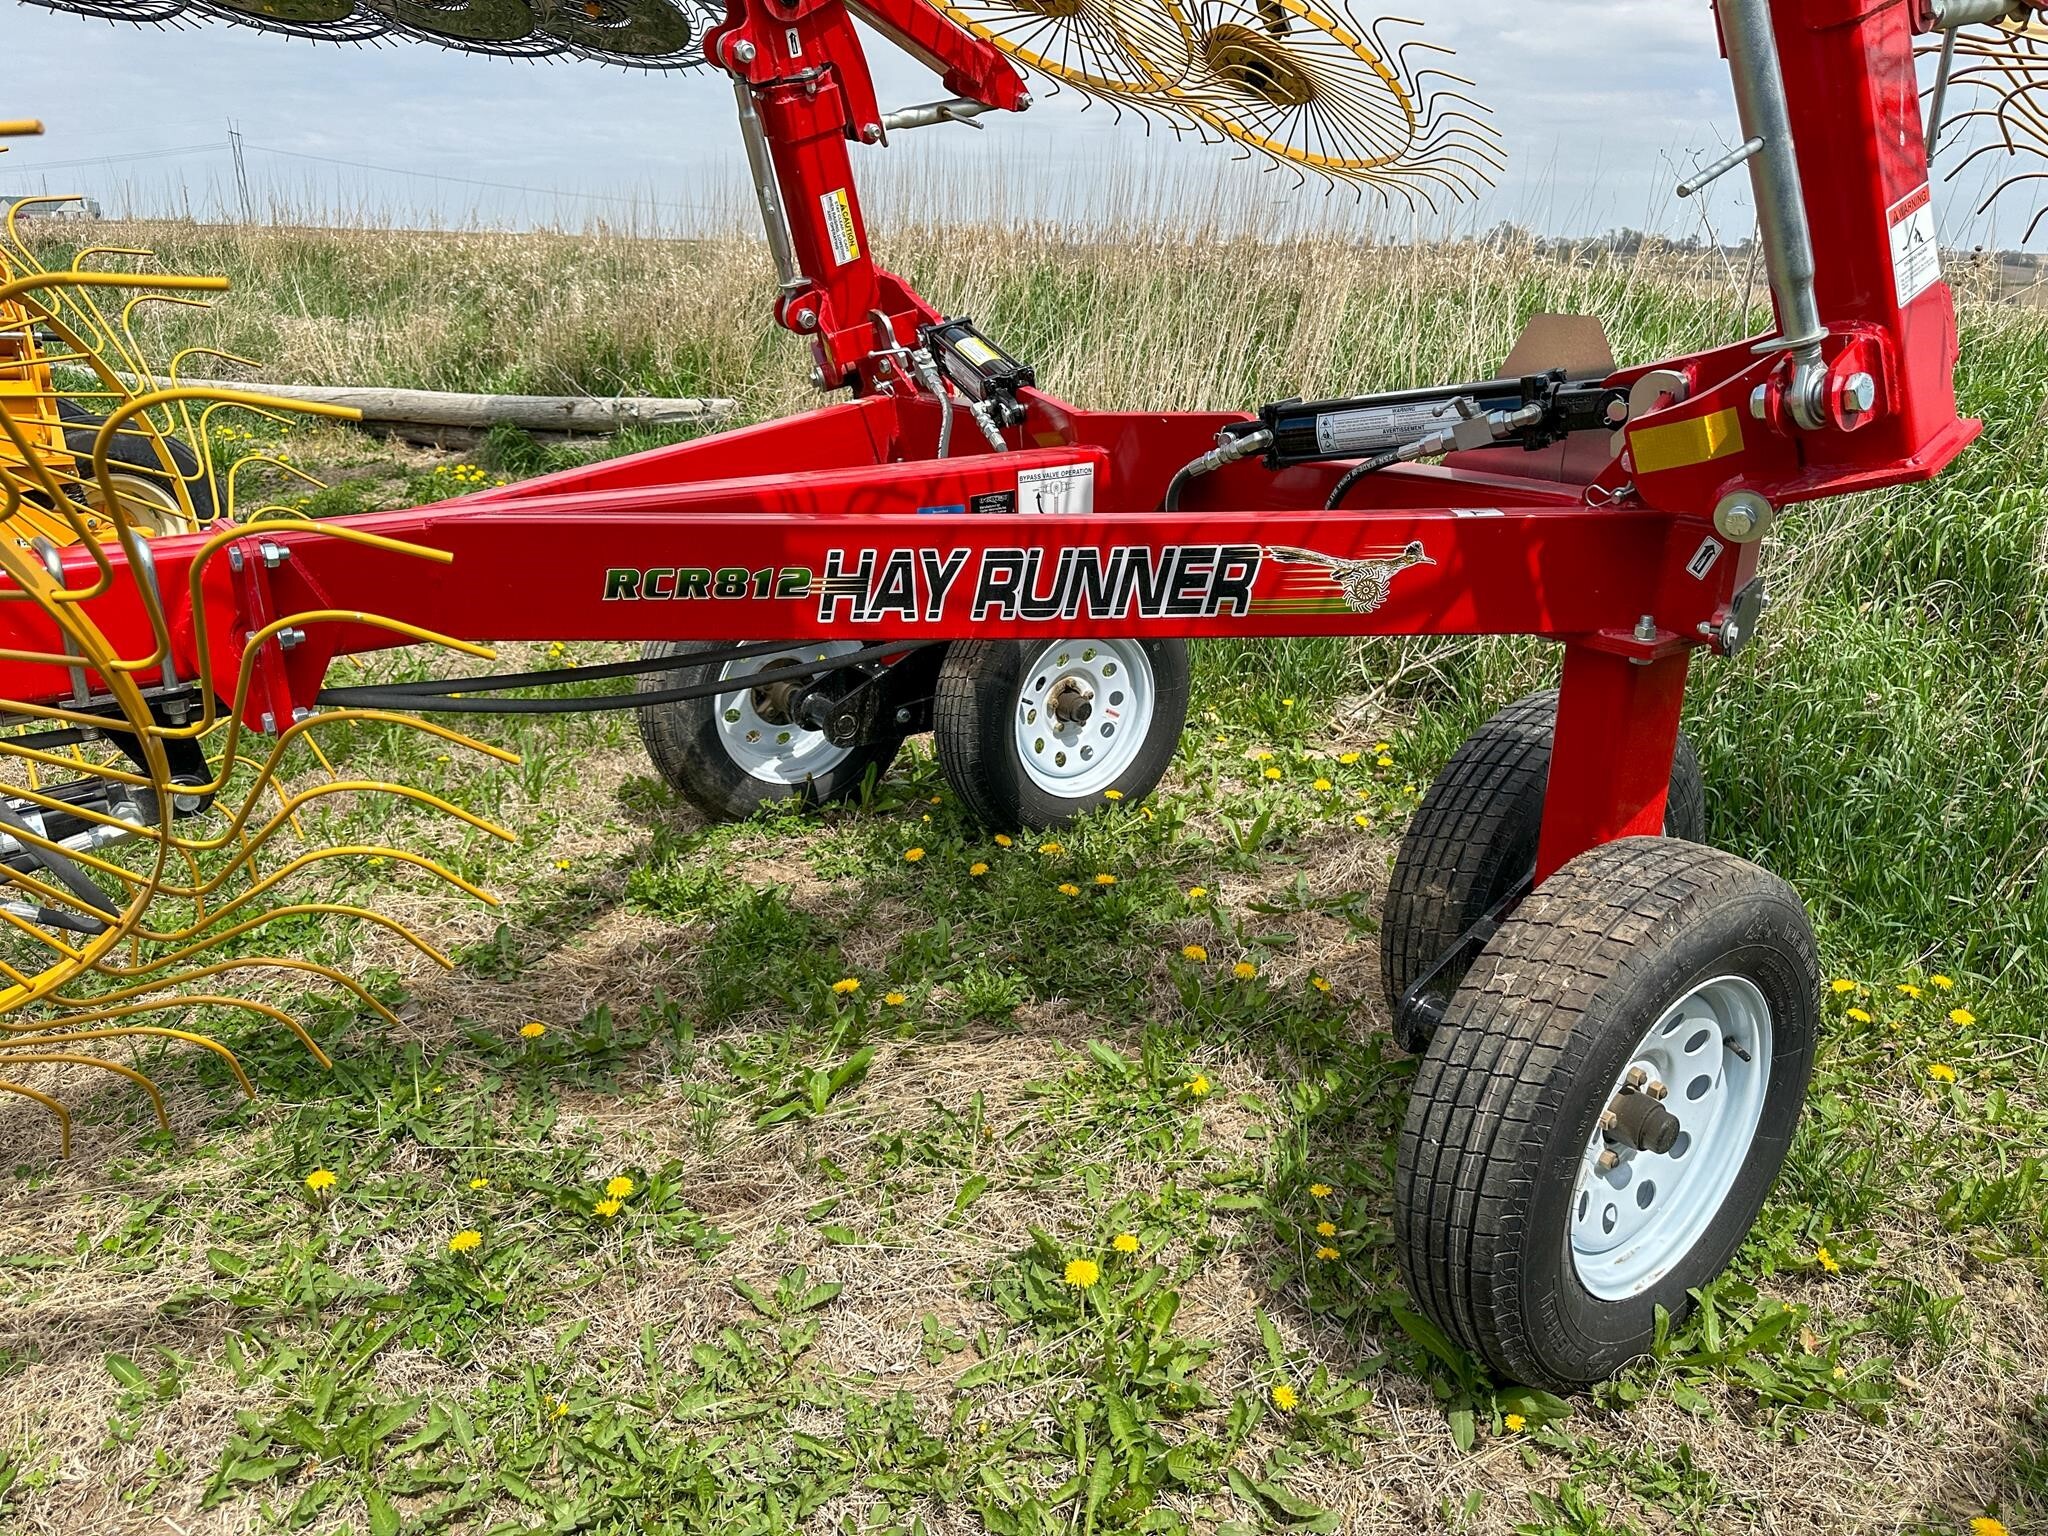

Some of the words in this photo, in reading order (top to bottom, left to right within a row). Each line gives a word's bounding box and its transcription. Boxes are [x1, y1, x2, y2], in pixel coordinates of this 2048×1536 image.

[1899, 191, 1927, 217] WARNING
[842, 211, 856, 247] CAUTION
[1382, 424, 1425, 434] AVERTISSEMENT
[1019, 473, 1041, 482] BYPASS
[1042, 471, 1060, 479] VALVE
[1060, 467, 1092, 477] OPERATION
[602, 566, 813, 600] RCR812
[817, 548, 971, 622] HAY
[969, 545, 1263, 622] RUNNER
